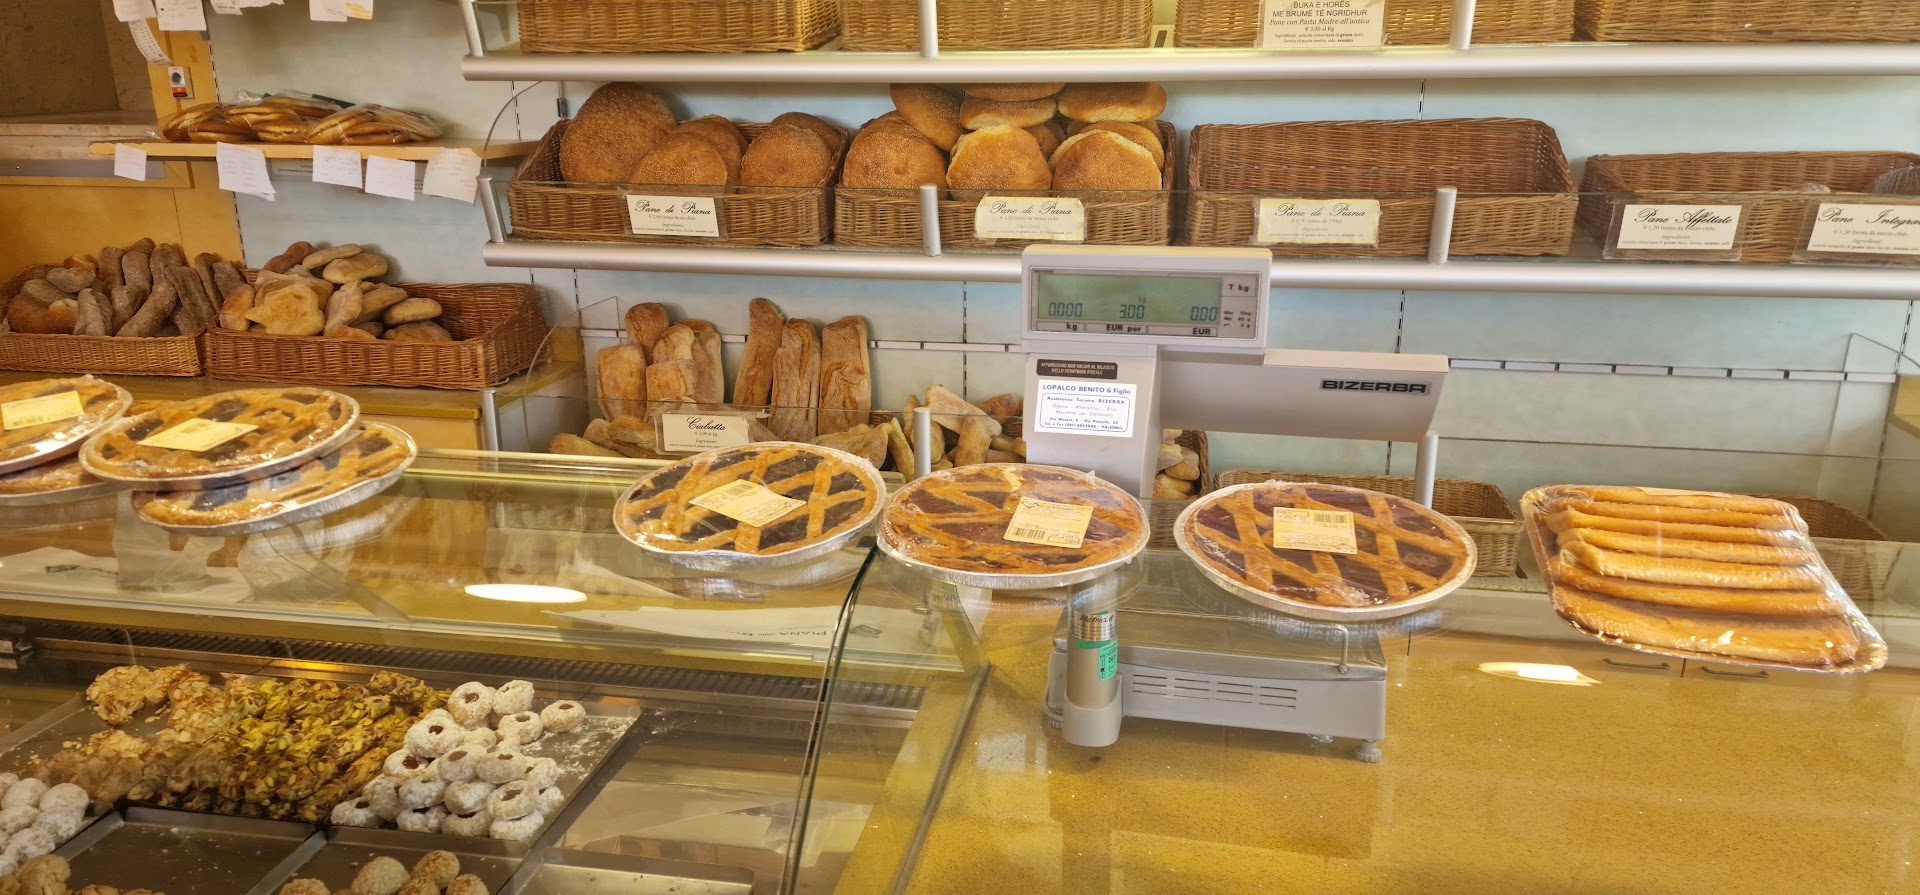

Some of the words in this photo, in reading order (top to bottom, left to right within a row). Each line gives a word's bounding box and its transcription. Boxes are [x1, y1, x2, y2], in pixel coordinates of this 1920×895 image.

[635, 200, 660, 212] Pane
[665, 205, 674, 213] di
[681, 201, 711, 214] Piana
[990, 201, 1017, 213] Pane
[1022, 205, 1033, 214] di
[1039, 201, 1071, 214] Piana
[1275, 203, 1305, 216] Pane
[1311, 207, 1323, 216] di
[1330, 203, 1365, 216] Piana
[1635, 208, 1668, 223] Pane
[1675, 209, 1732, 228] Affettato
[1818, 207, 1853, 222] Pane
[1238, 284, 1249, 292] kg
[1322, 380, 1426, 393] BIZERBA
[687, 417, 725, 430] Ciabatta
